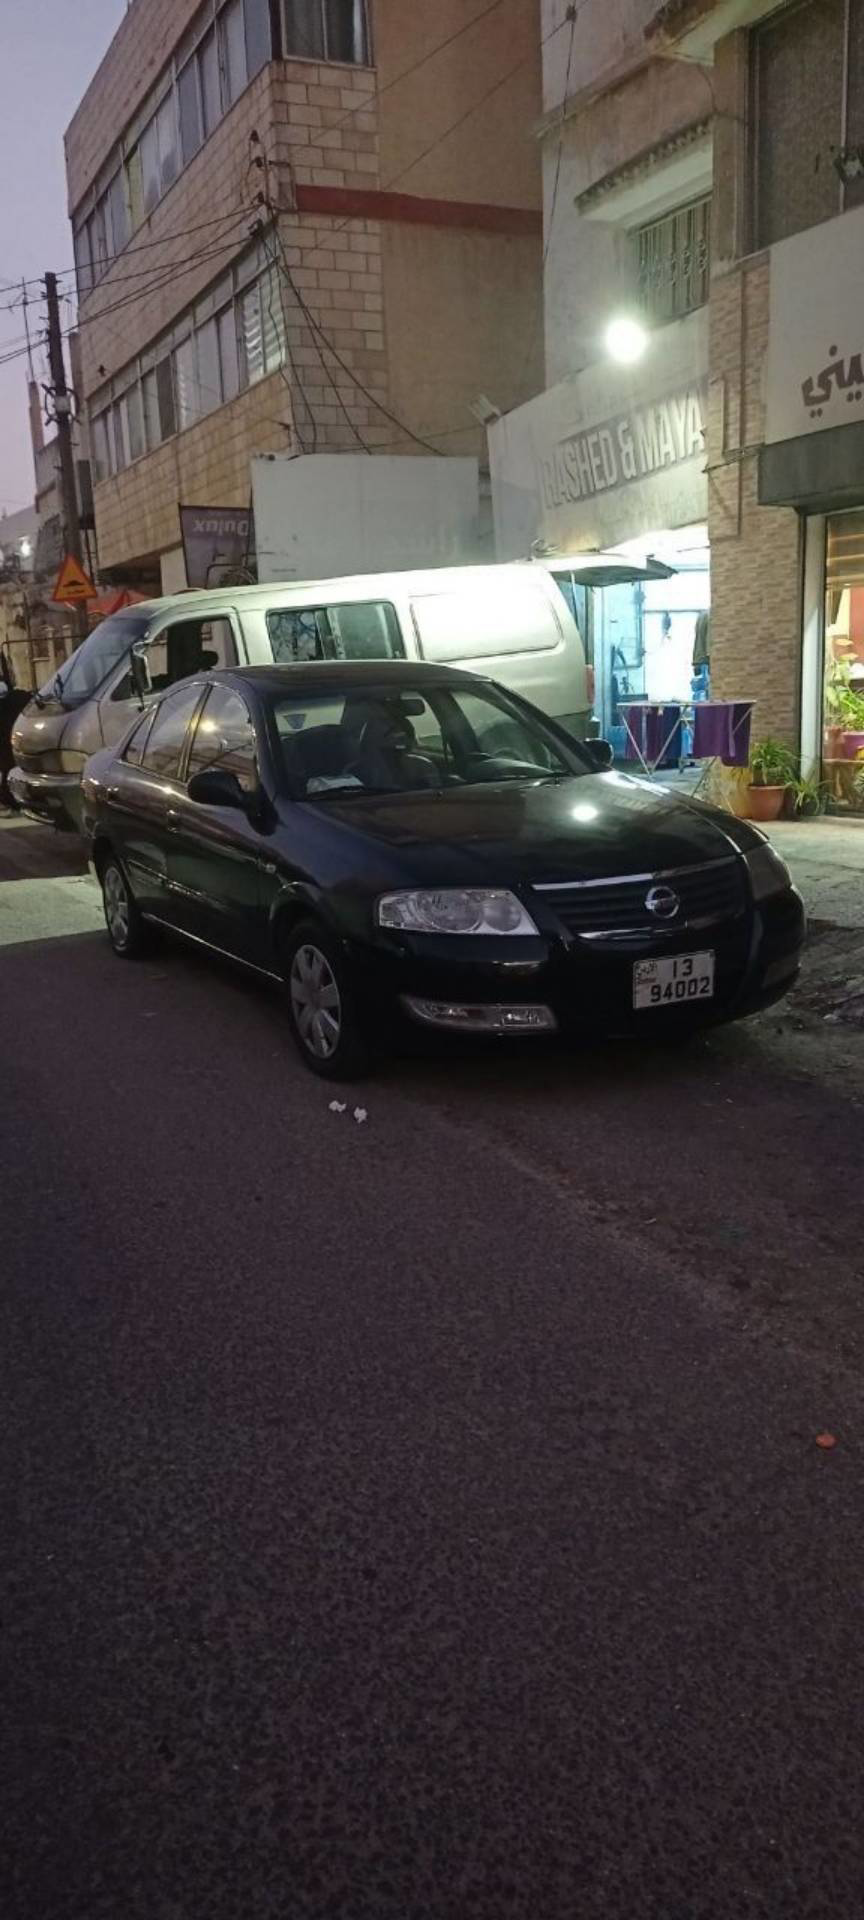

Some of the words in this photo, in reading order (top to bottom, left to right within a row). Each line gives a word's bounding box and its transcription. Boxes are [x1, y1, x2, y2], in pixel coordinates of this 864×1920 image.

[617, 420, 637, 480] &
[635, 386, 705, 474] MAYA
[192, 519, 249, 536] Dulux
[673, 959, 693, 978] 13
[650, 976, 710, 1002] 94002
